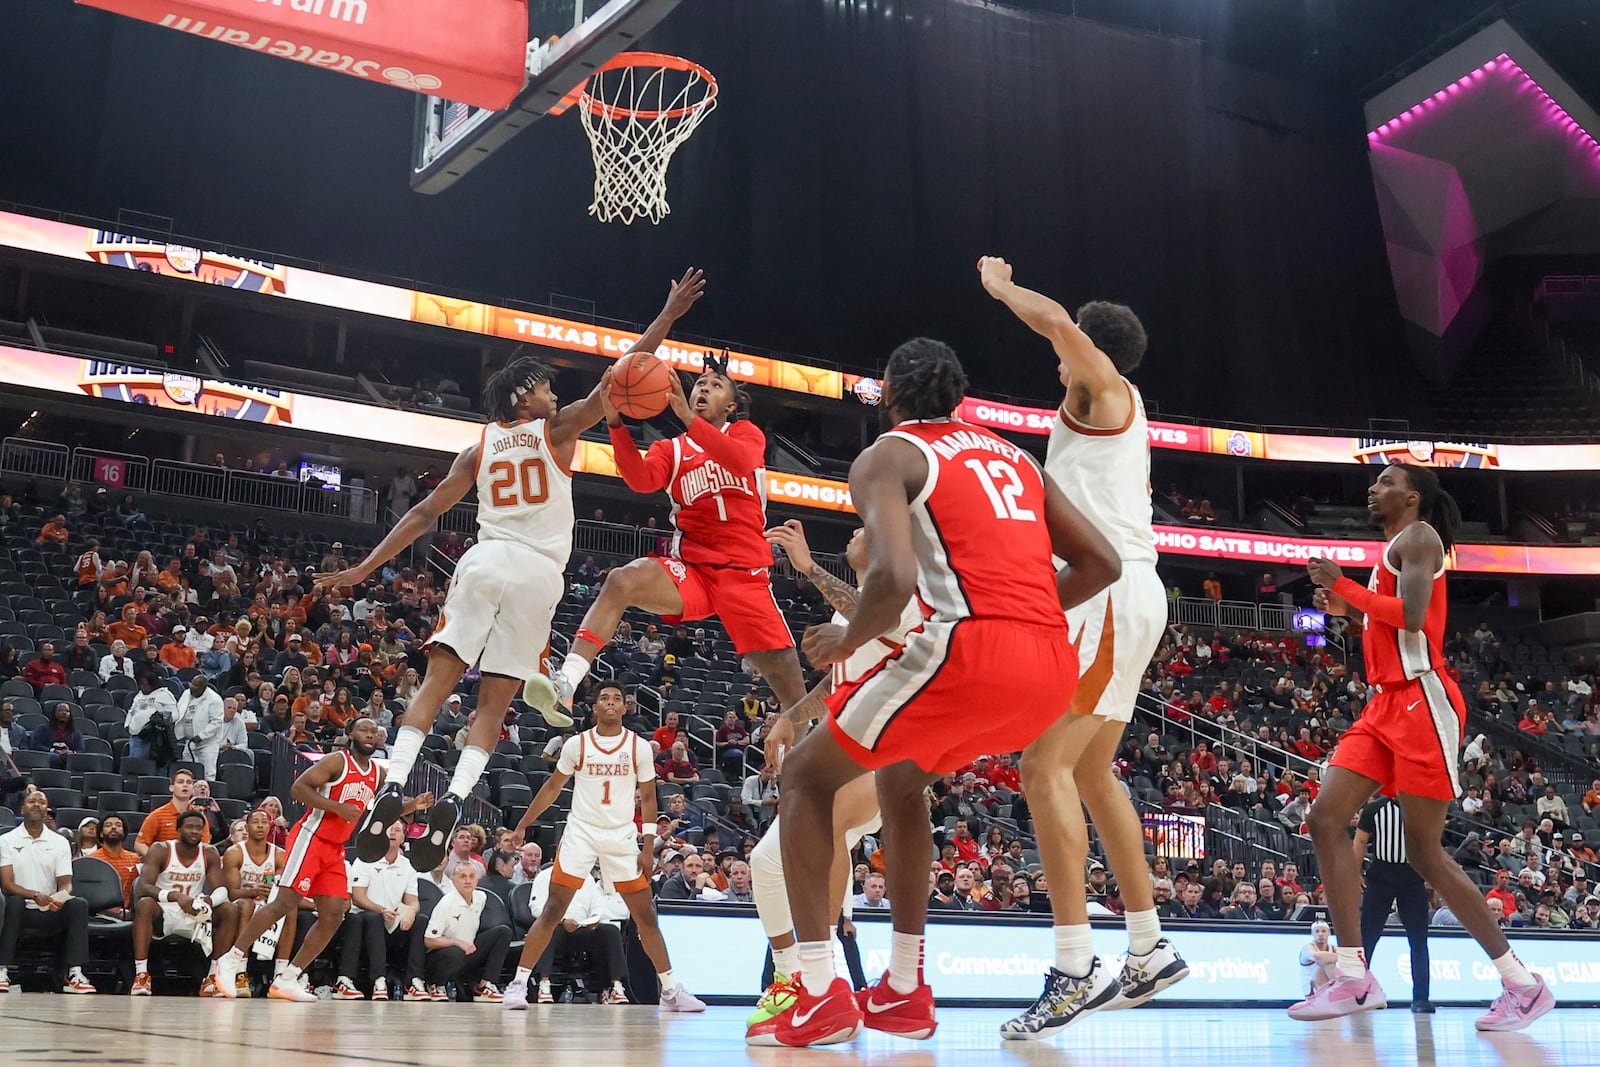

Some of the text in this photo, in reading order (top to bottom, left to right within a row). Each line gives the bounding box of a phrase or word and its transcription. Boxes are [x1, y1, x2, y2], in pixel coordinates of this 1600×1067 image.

[513, 317, 598, 348] TEXAS
[975, 405, 1024, 426] OHIO
[492, 433, 542, 455] JOHNSON
[930, 430, 1023, 464] MAHAFFEY
[101, 464, 120, 482] 16
[489, 458, 549, 507] 20
[964, 458, 1037, 521] 12
[712, 494, 728, 522] 1
[1199, 536, 1251, 554] SATE
[1254, 540, 1366, 562] BUCKEYES
[586, 763, 630, 776] TEXAS
[601, 780, 611, 805] 1
[168, 871, 201, 882] TEXAS
[242, 871, 264, 880] TEX
